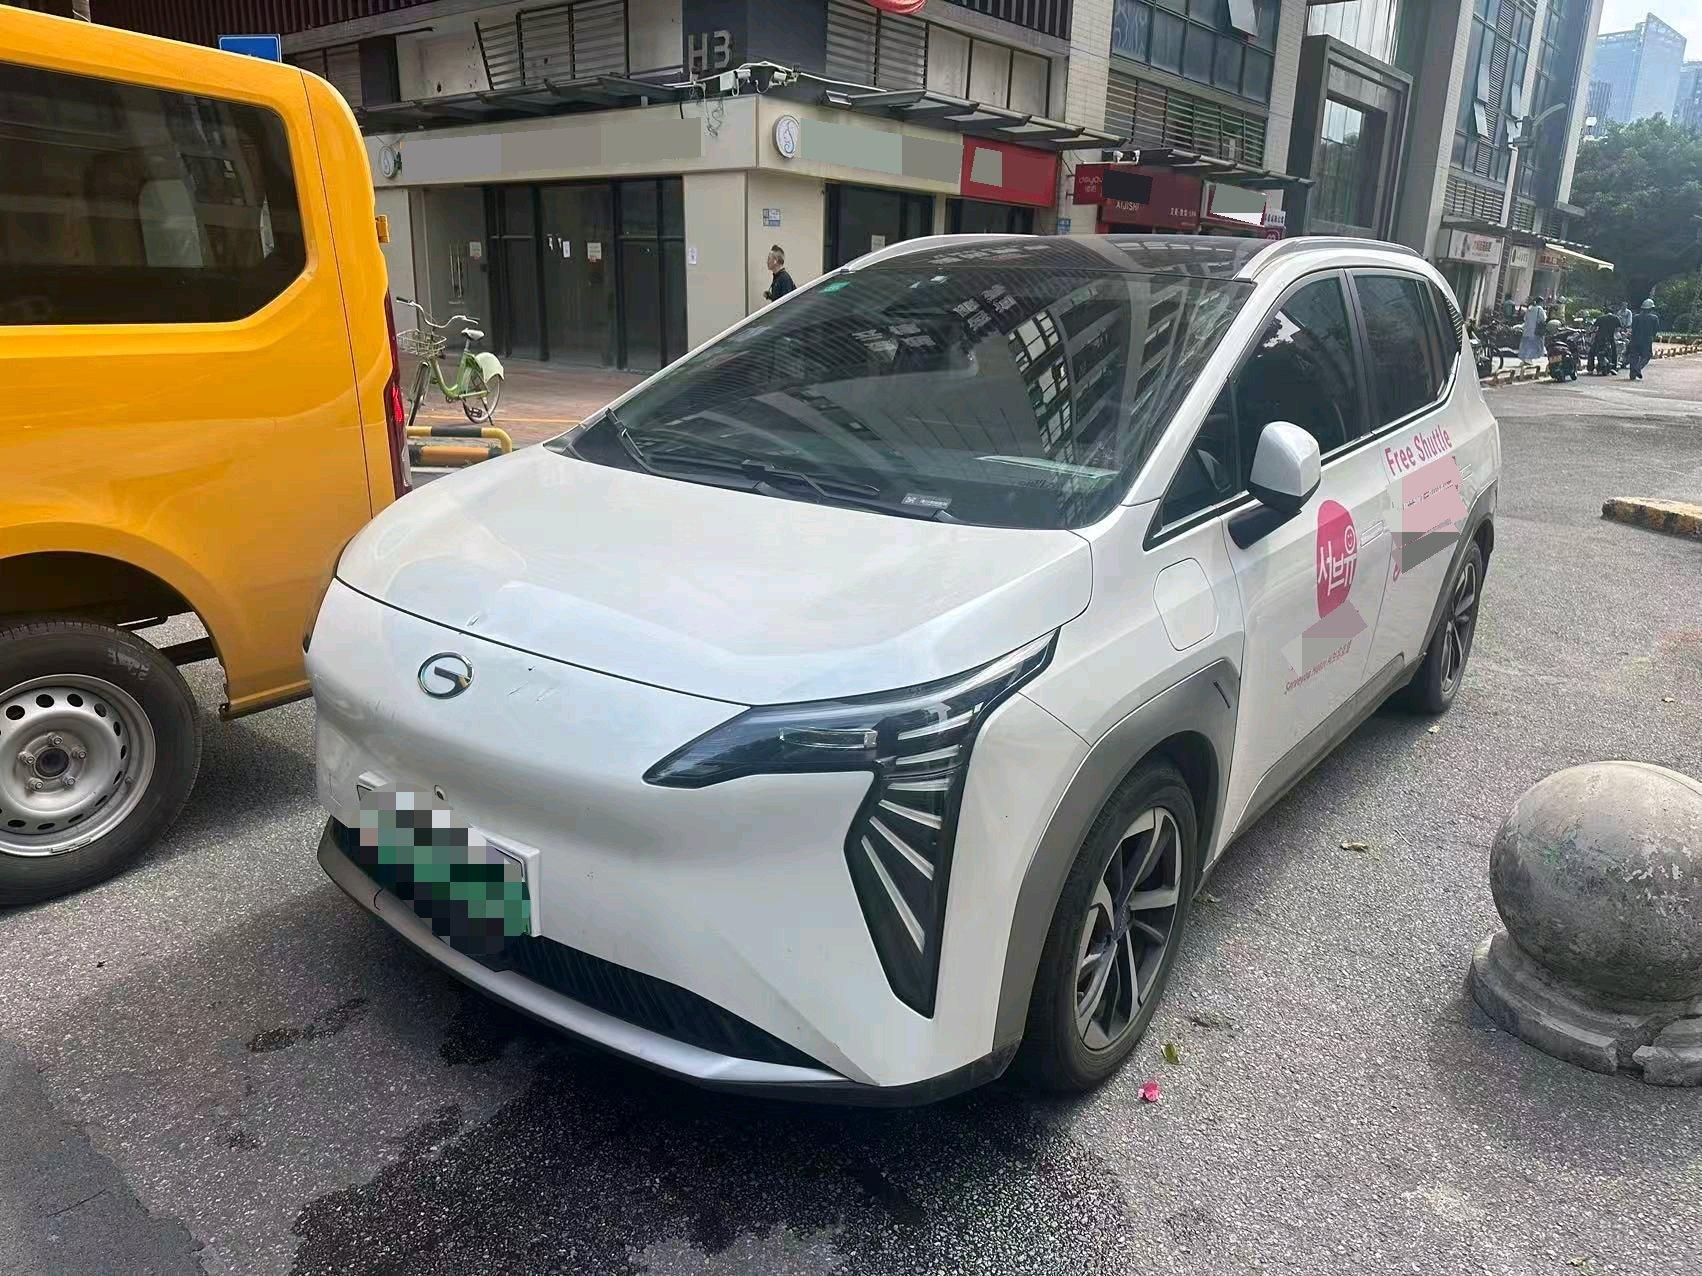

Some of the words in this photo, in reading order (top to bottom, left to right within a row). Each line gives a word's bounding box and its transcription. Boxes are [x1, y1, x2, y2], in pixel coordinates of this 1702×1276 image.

[688, 30, 731, 71] H3
[1384, 445, 1416, 476] Free
[1413, 424, 1453, 462] Shuttle
